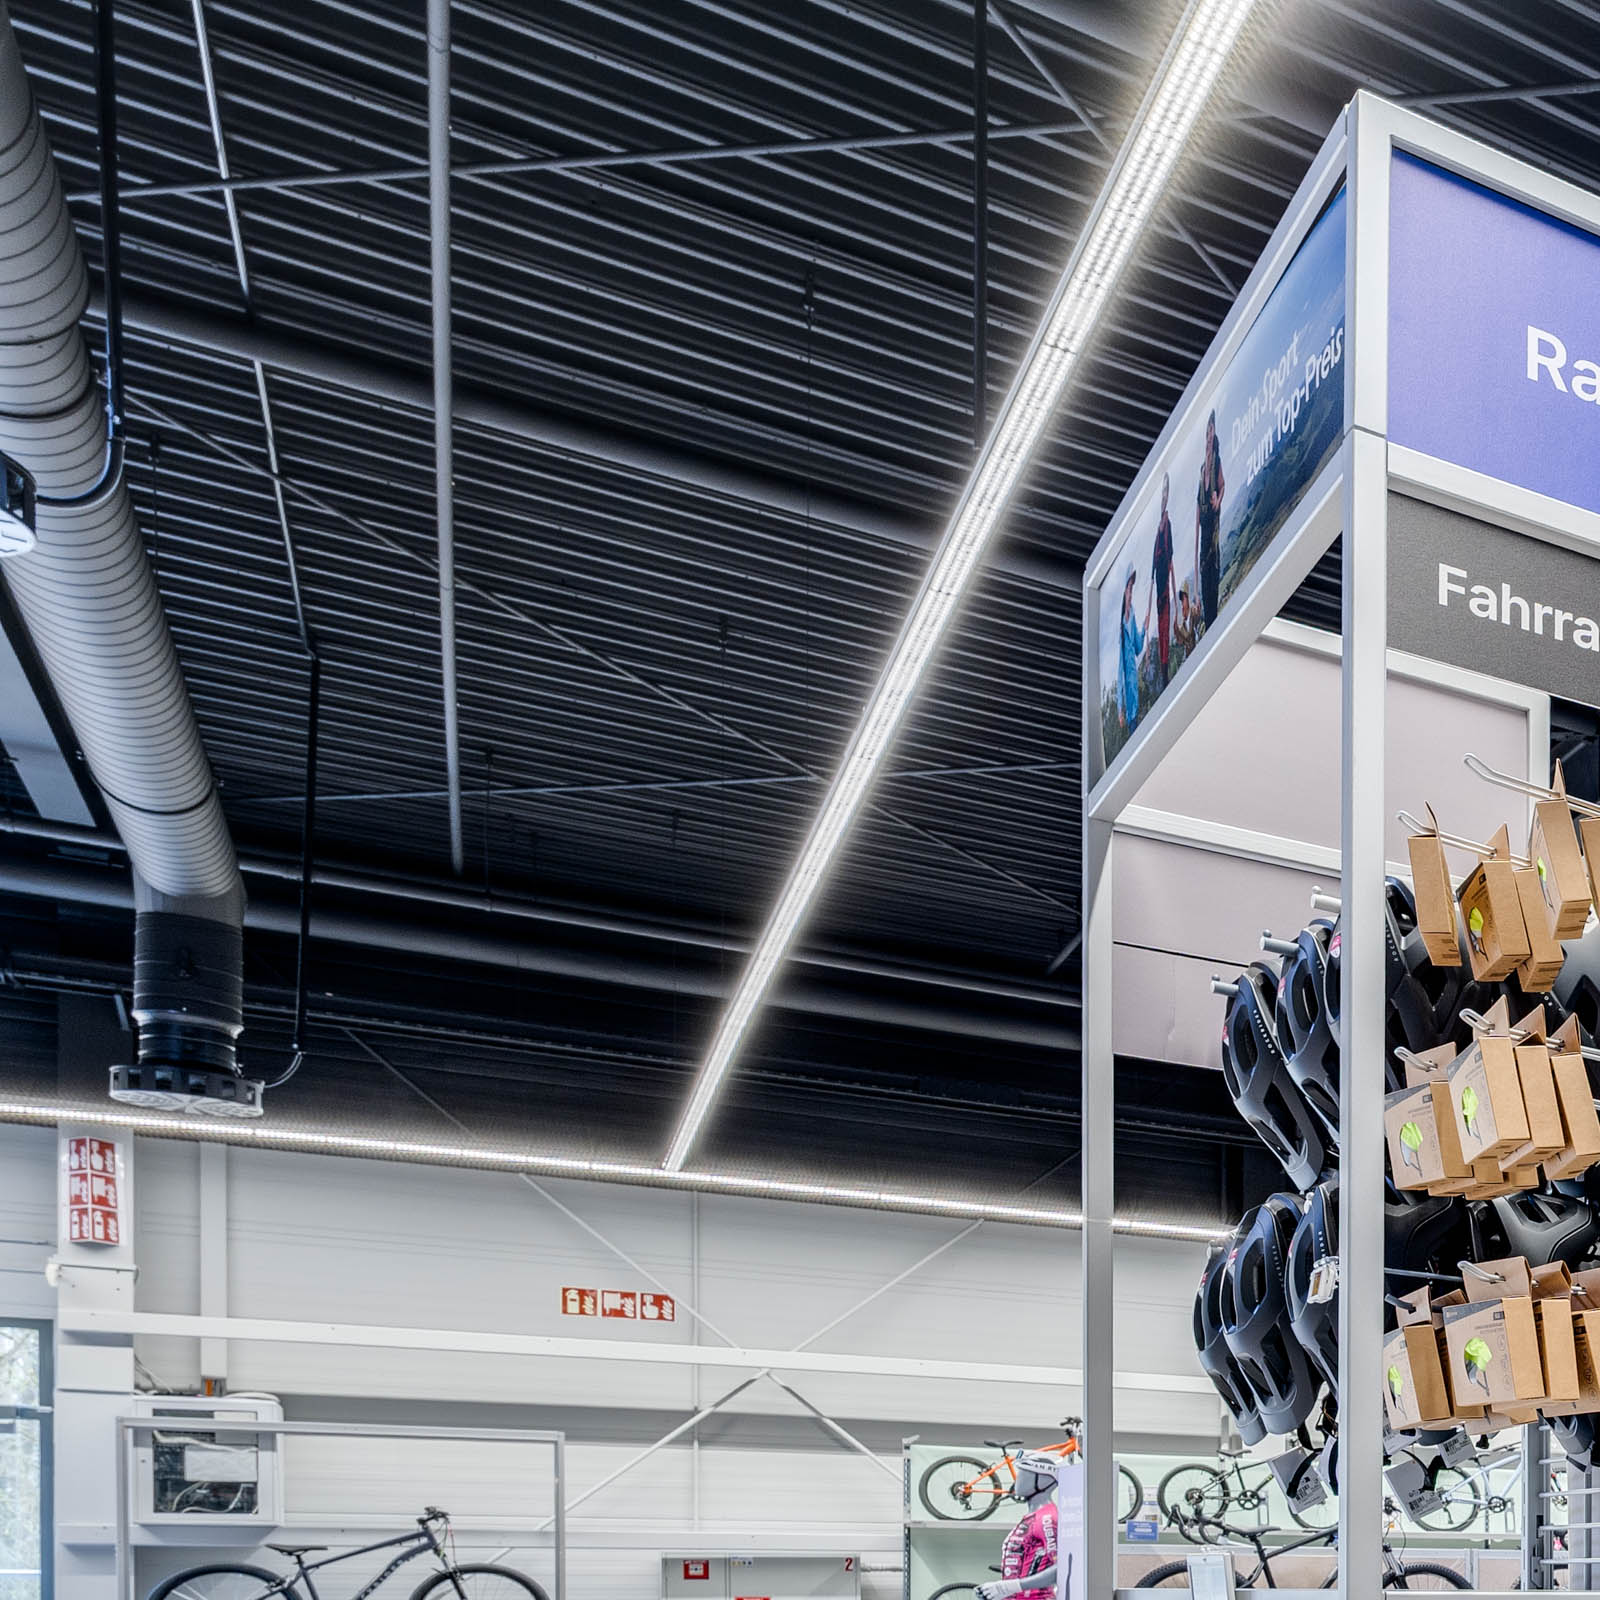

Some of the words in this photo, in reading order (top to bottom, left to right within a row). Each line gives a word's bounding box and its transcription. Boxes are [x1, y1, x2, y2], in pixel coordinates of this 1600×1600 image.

[1231, 396, 1260, 453] Dein
[1260, 330, 1300, 415] Sport
[1246, 427, 1274, 487] zum
[1274, 326, 1344, 442] Top-Preis
[844, 1557, 854, 1572] 2
